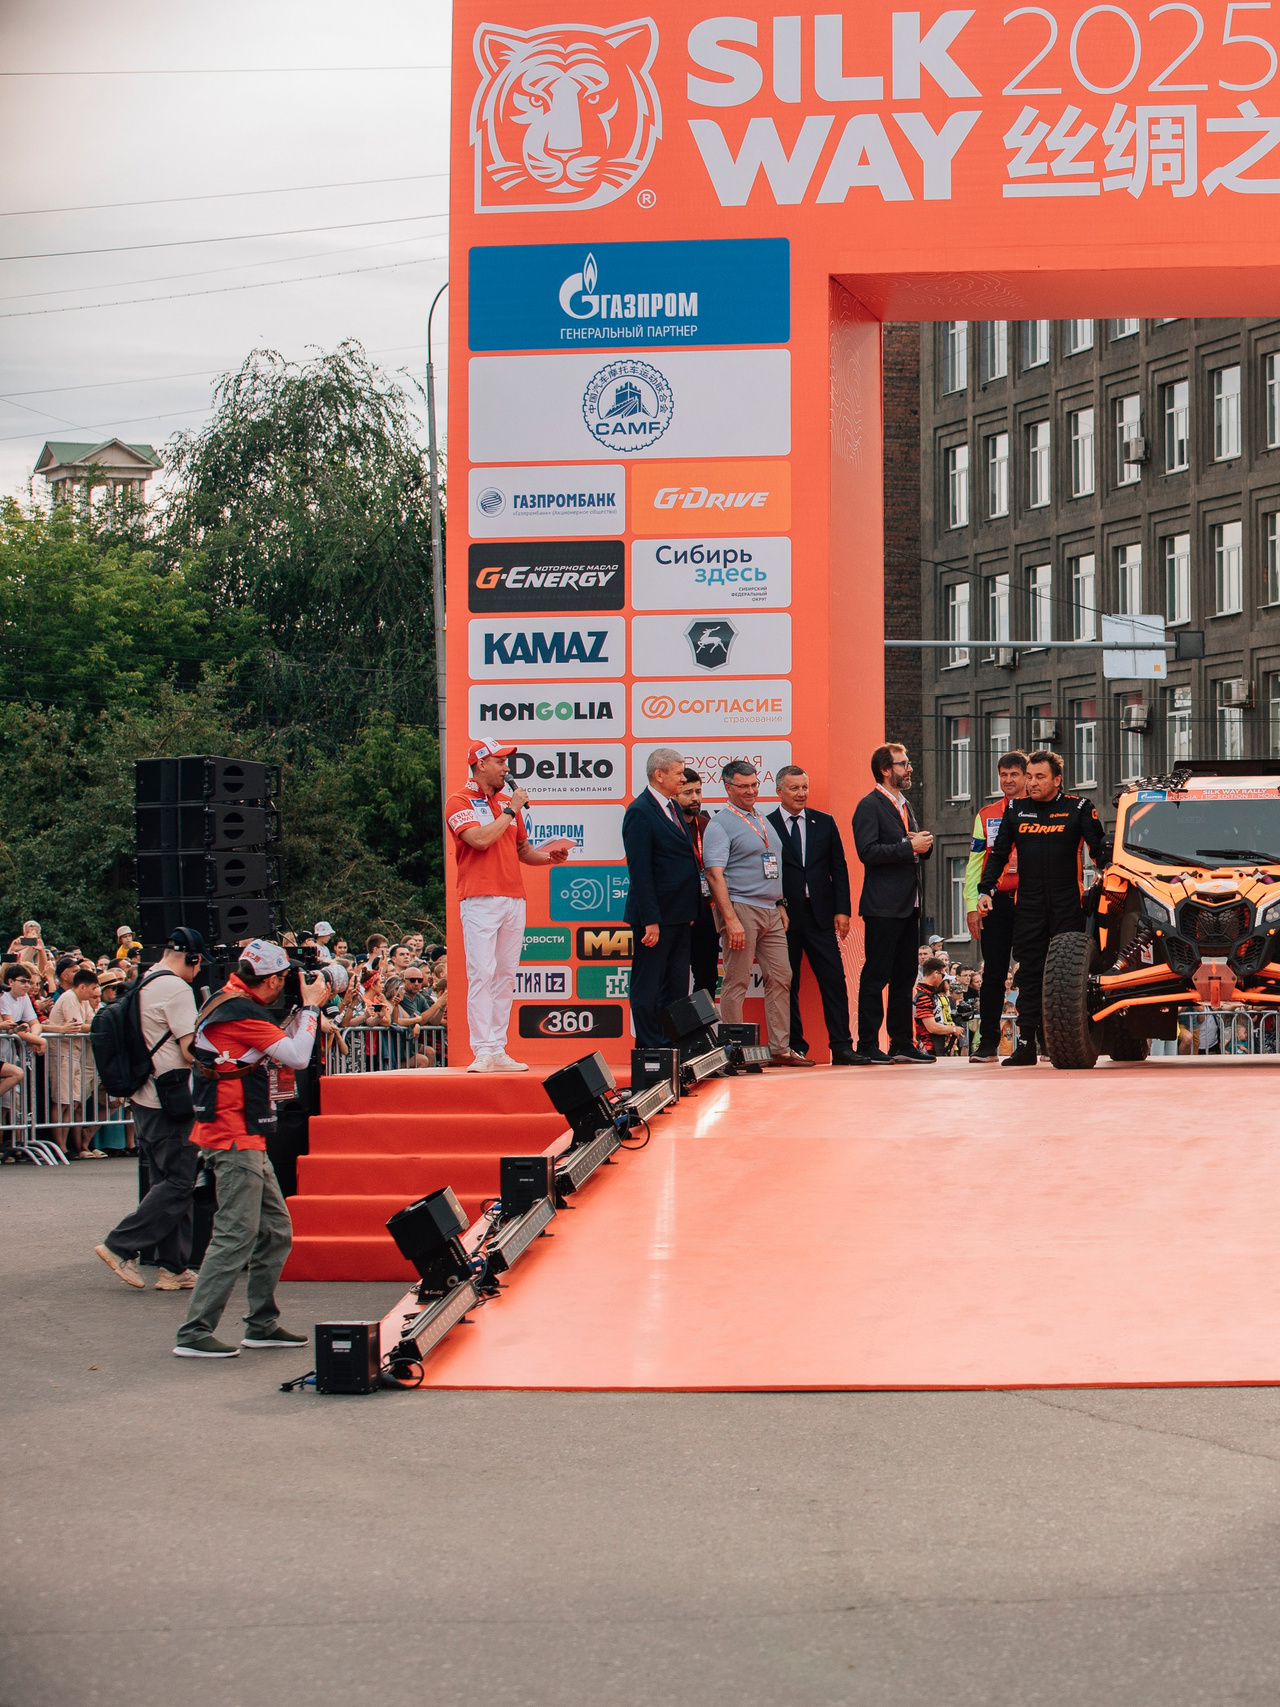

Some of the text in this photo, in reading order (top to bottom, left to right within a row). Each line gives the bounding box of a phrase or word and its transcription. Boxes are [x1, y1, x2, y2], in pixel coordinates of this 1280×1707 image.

[687, 9, 983, 107] SILK
[1002, 3, 1278, 96] 2025
[687, 110, 983, 206] WAY
[601, 292, 698, 319] ГАЗПРОМ
[560, 325, 698, 340] ГЕНЕРАЛЬНЫЙ ПАРТНЕР
[595, 421, 661, 435] CAMF
[513, 493, 616, 508] ГАЗПРОМБАНК
[655, 544, 753, 568] Сибирь
[694, 567, 767, 586] здесь
[484, 631, 608, 664] KAMAZ
[480, 702, 613, 721] MONGOLIA
[678, 698, 782, 714] СОГЛАСИЕ
[723, 716, 782, 724] страхование
[507, 752, 613, 779] Delko
[535, 824, 584, 838] ГАЗПРОМ
[584, 930, 634, 956] МАТ
[548, 1011, 593, 1031] 360
